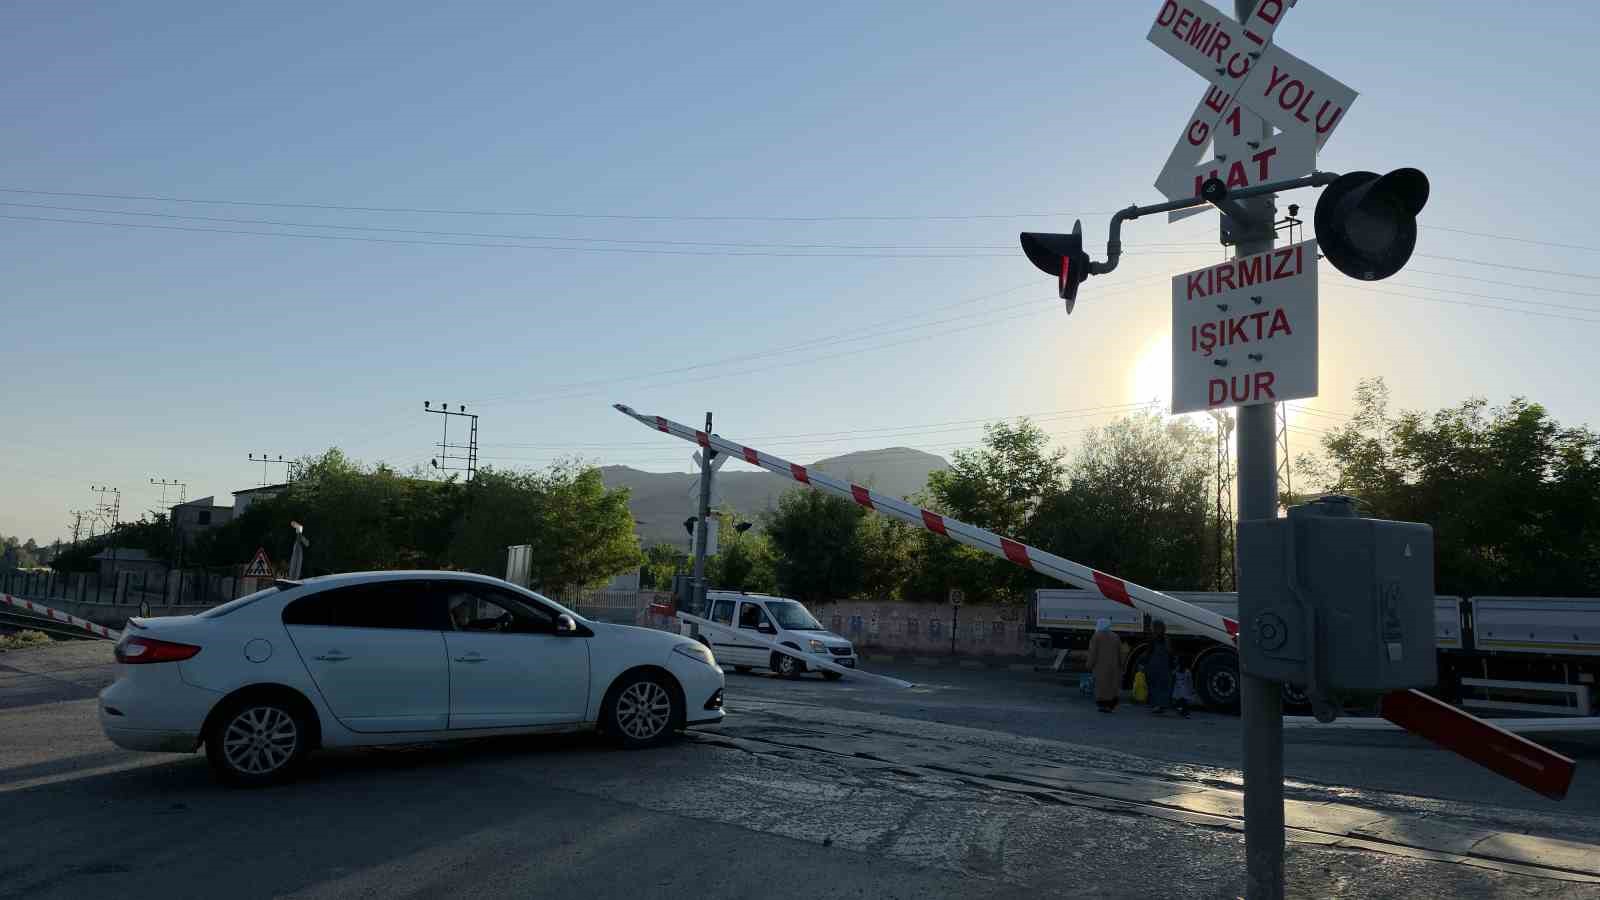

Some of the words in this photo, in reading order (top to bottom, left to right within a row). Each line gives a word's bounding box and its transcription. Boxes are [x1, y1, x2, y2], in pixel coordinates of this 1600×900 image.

[1157, 0, 1231, 64] DEMİR
[1264, 66, 1342, 134] YOLU
[1226, 106, 1241, 136] 1
[1187, 246, 1303, 300] KIRMIZI
[1192, 307, 1293, 357] IŞIKTA
[1208, 371, 1276, 406] DUR
